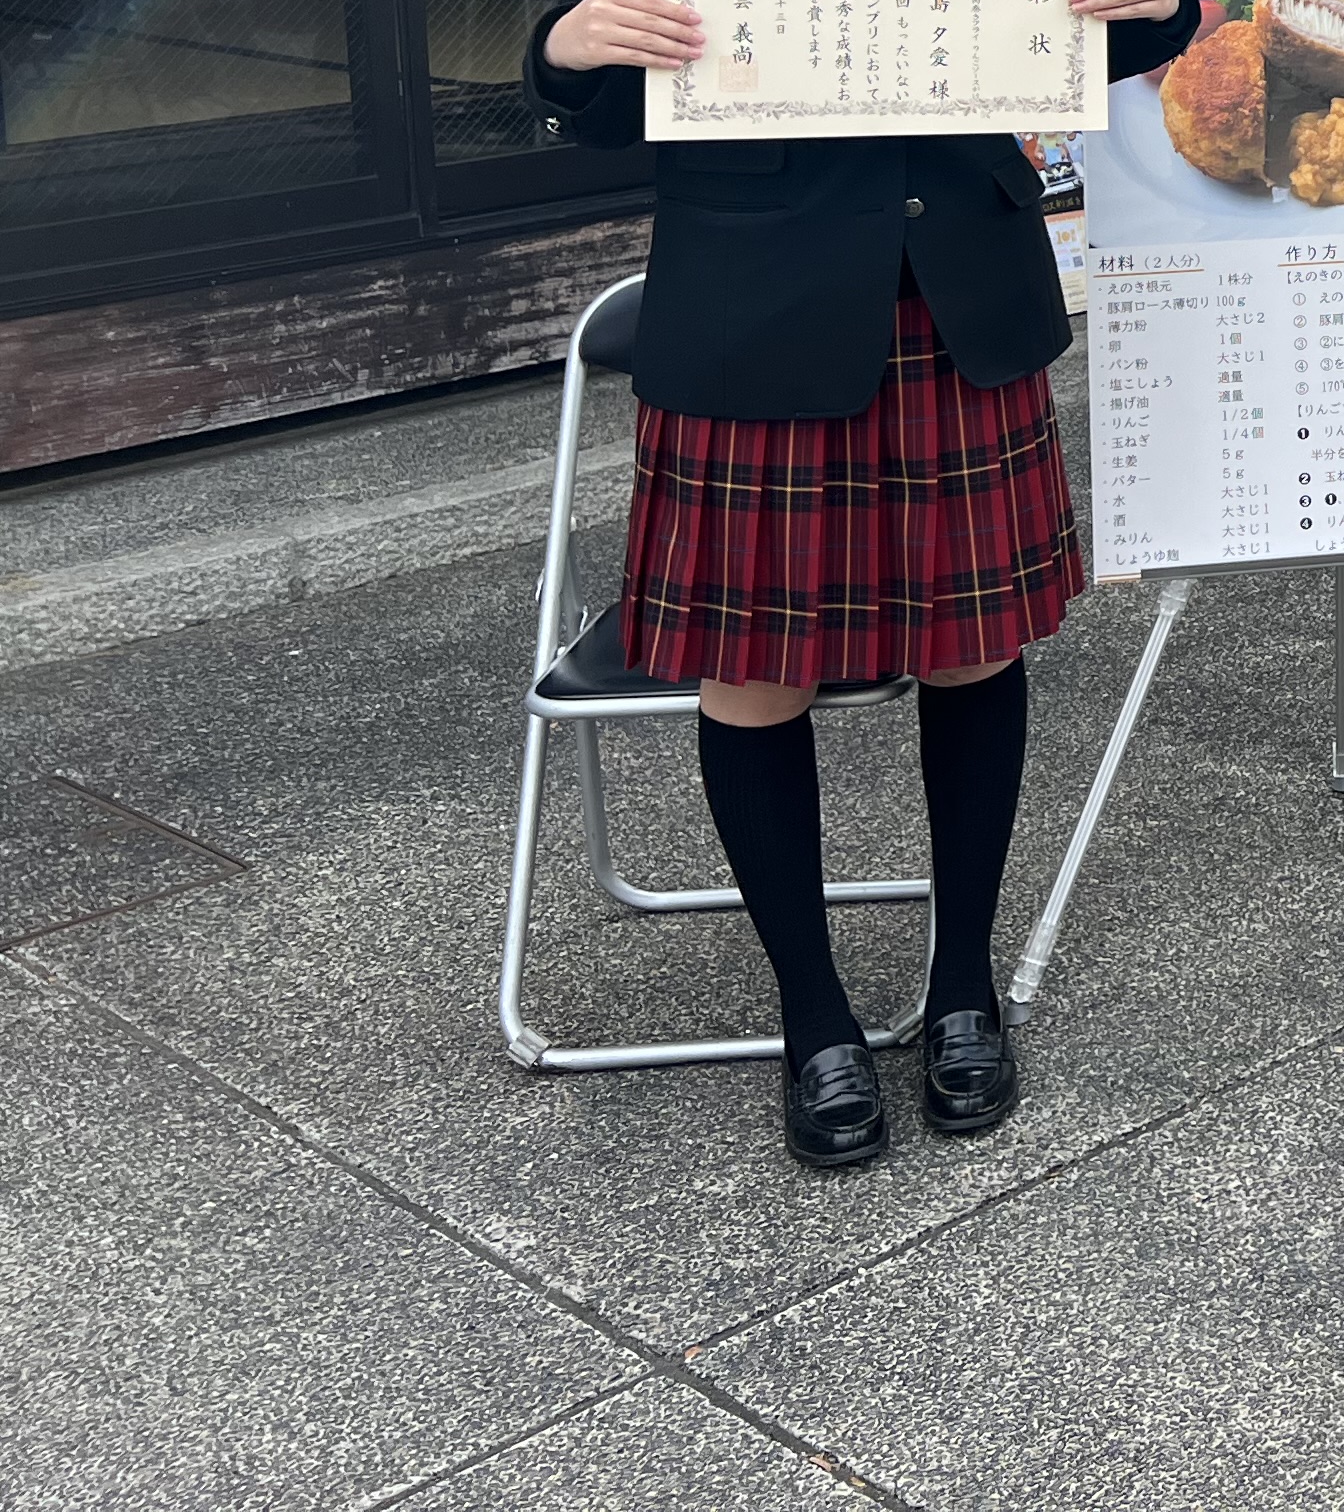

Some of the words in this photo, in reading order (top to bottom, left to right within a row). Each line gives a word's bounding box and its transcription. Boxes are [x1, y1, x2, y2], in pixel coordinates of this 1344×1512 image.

[929, 79, 949, 100] 様
[1284, 243, 1337, 262] 作り方
